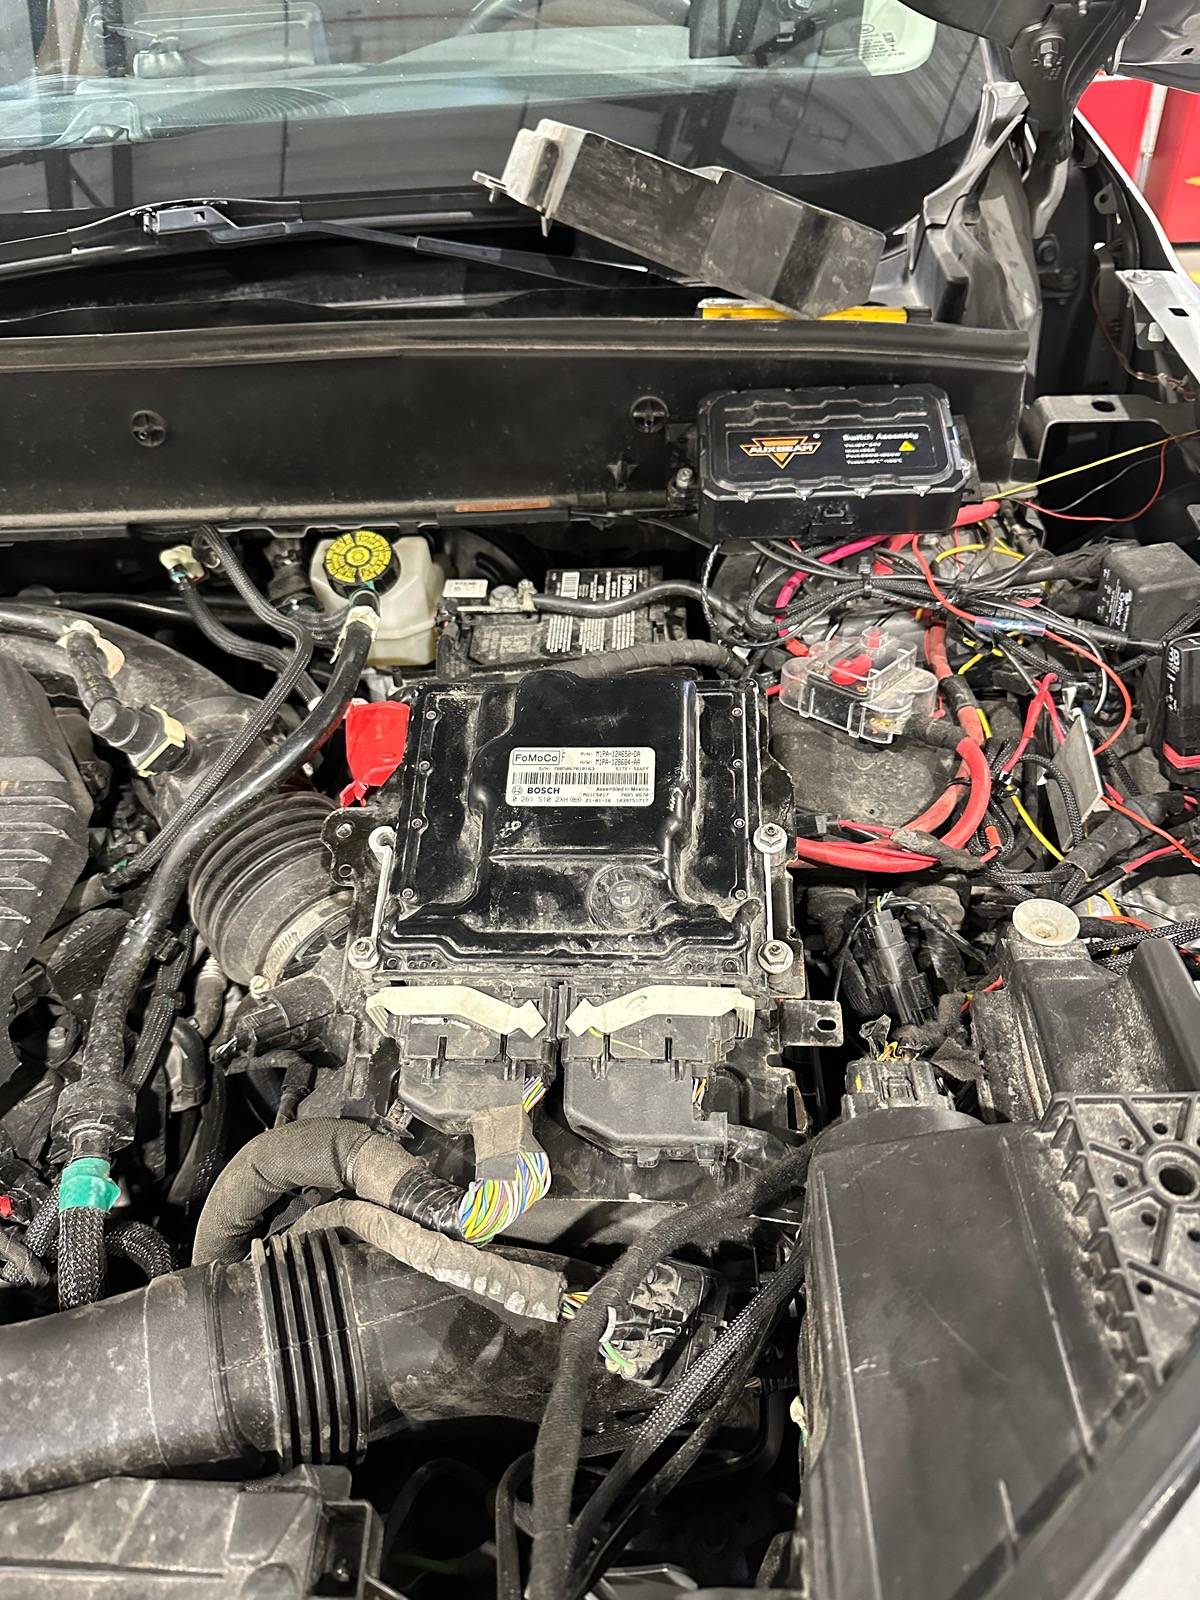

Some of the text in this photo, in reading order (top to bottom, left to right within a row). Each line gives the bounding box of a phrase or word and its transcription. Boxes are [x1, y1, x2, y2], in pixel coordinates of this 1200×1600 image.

[748, 444, 813, 454] AUXBEAM
[515, 754, 558, 762] FoMoCo
[527, 786, 560, 794] BOSCH
